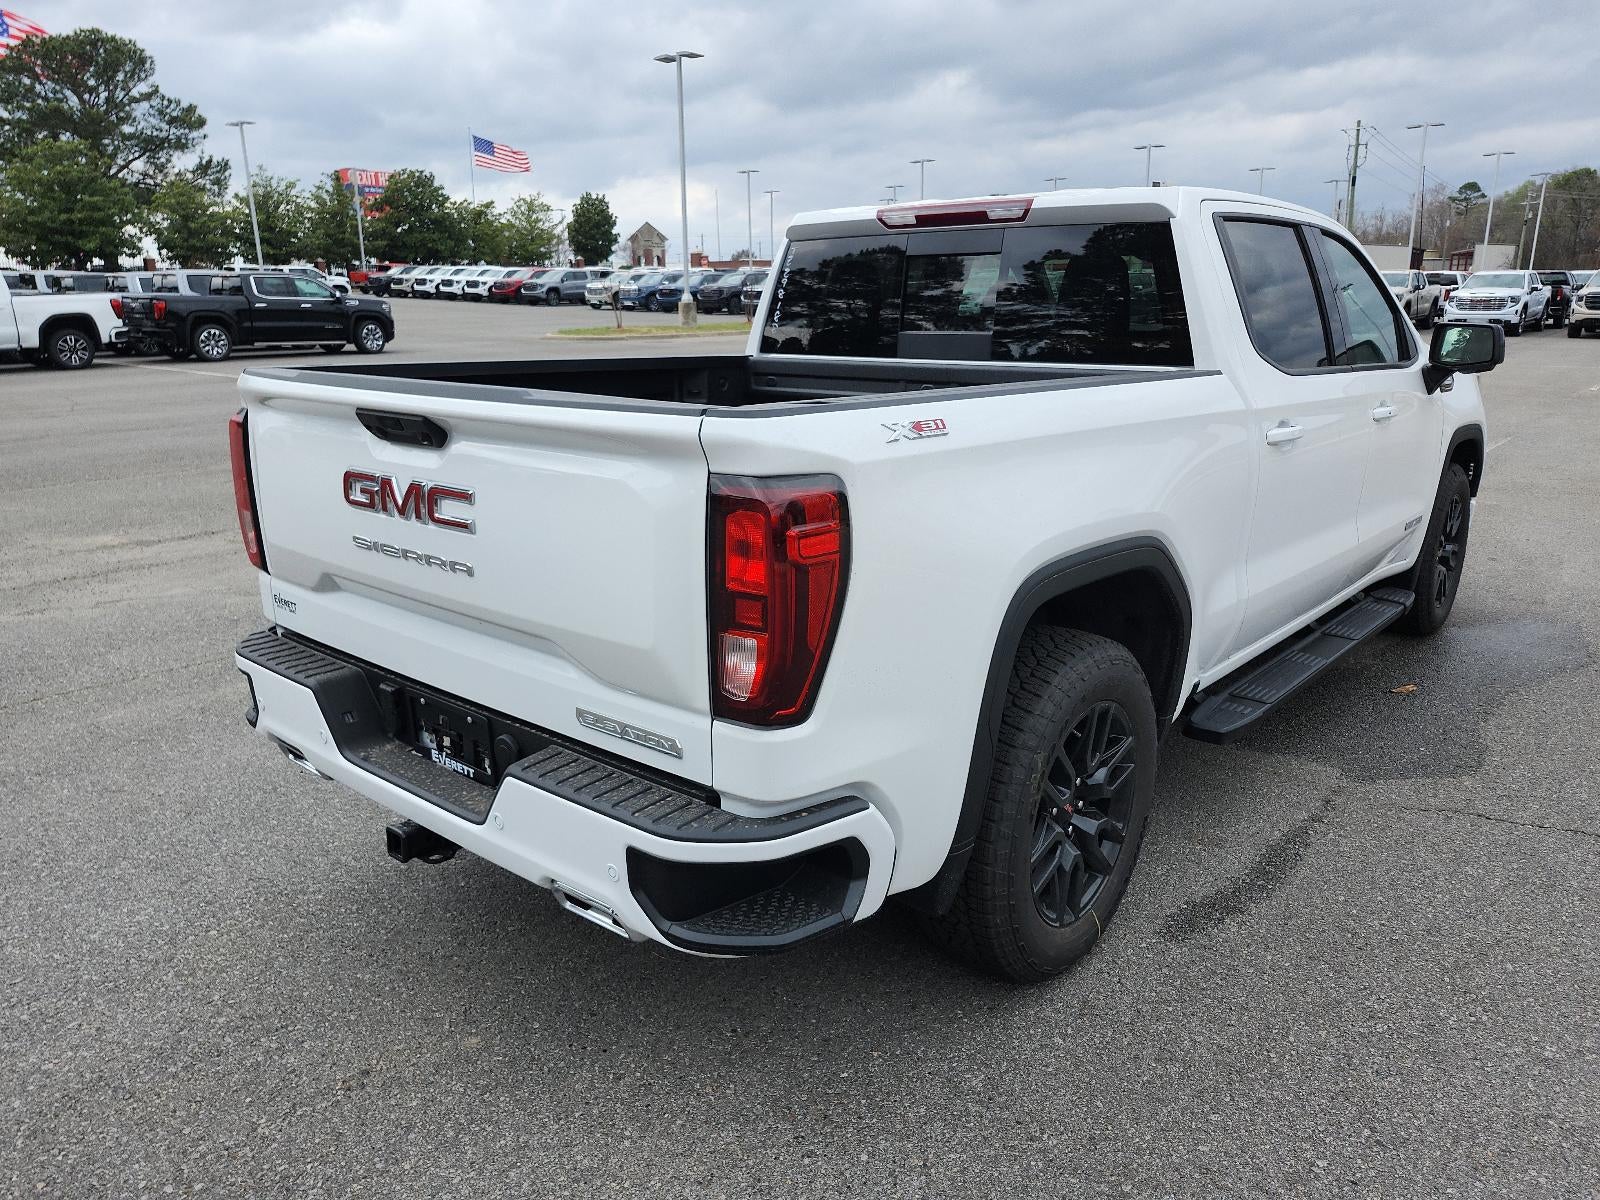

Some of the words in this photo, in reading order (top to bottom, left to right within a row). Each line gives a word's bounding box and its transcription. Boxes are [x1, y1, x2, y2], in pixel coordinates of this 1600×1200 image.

[343, 467, 476, 535] GMC
[353, 535, 475, 577] SIERRA
[582, 713, 675, 751] ELEVATION
[431, 749, 475, 778] EVERETT
